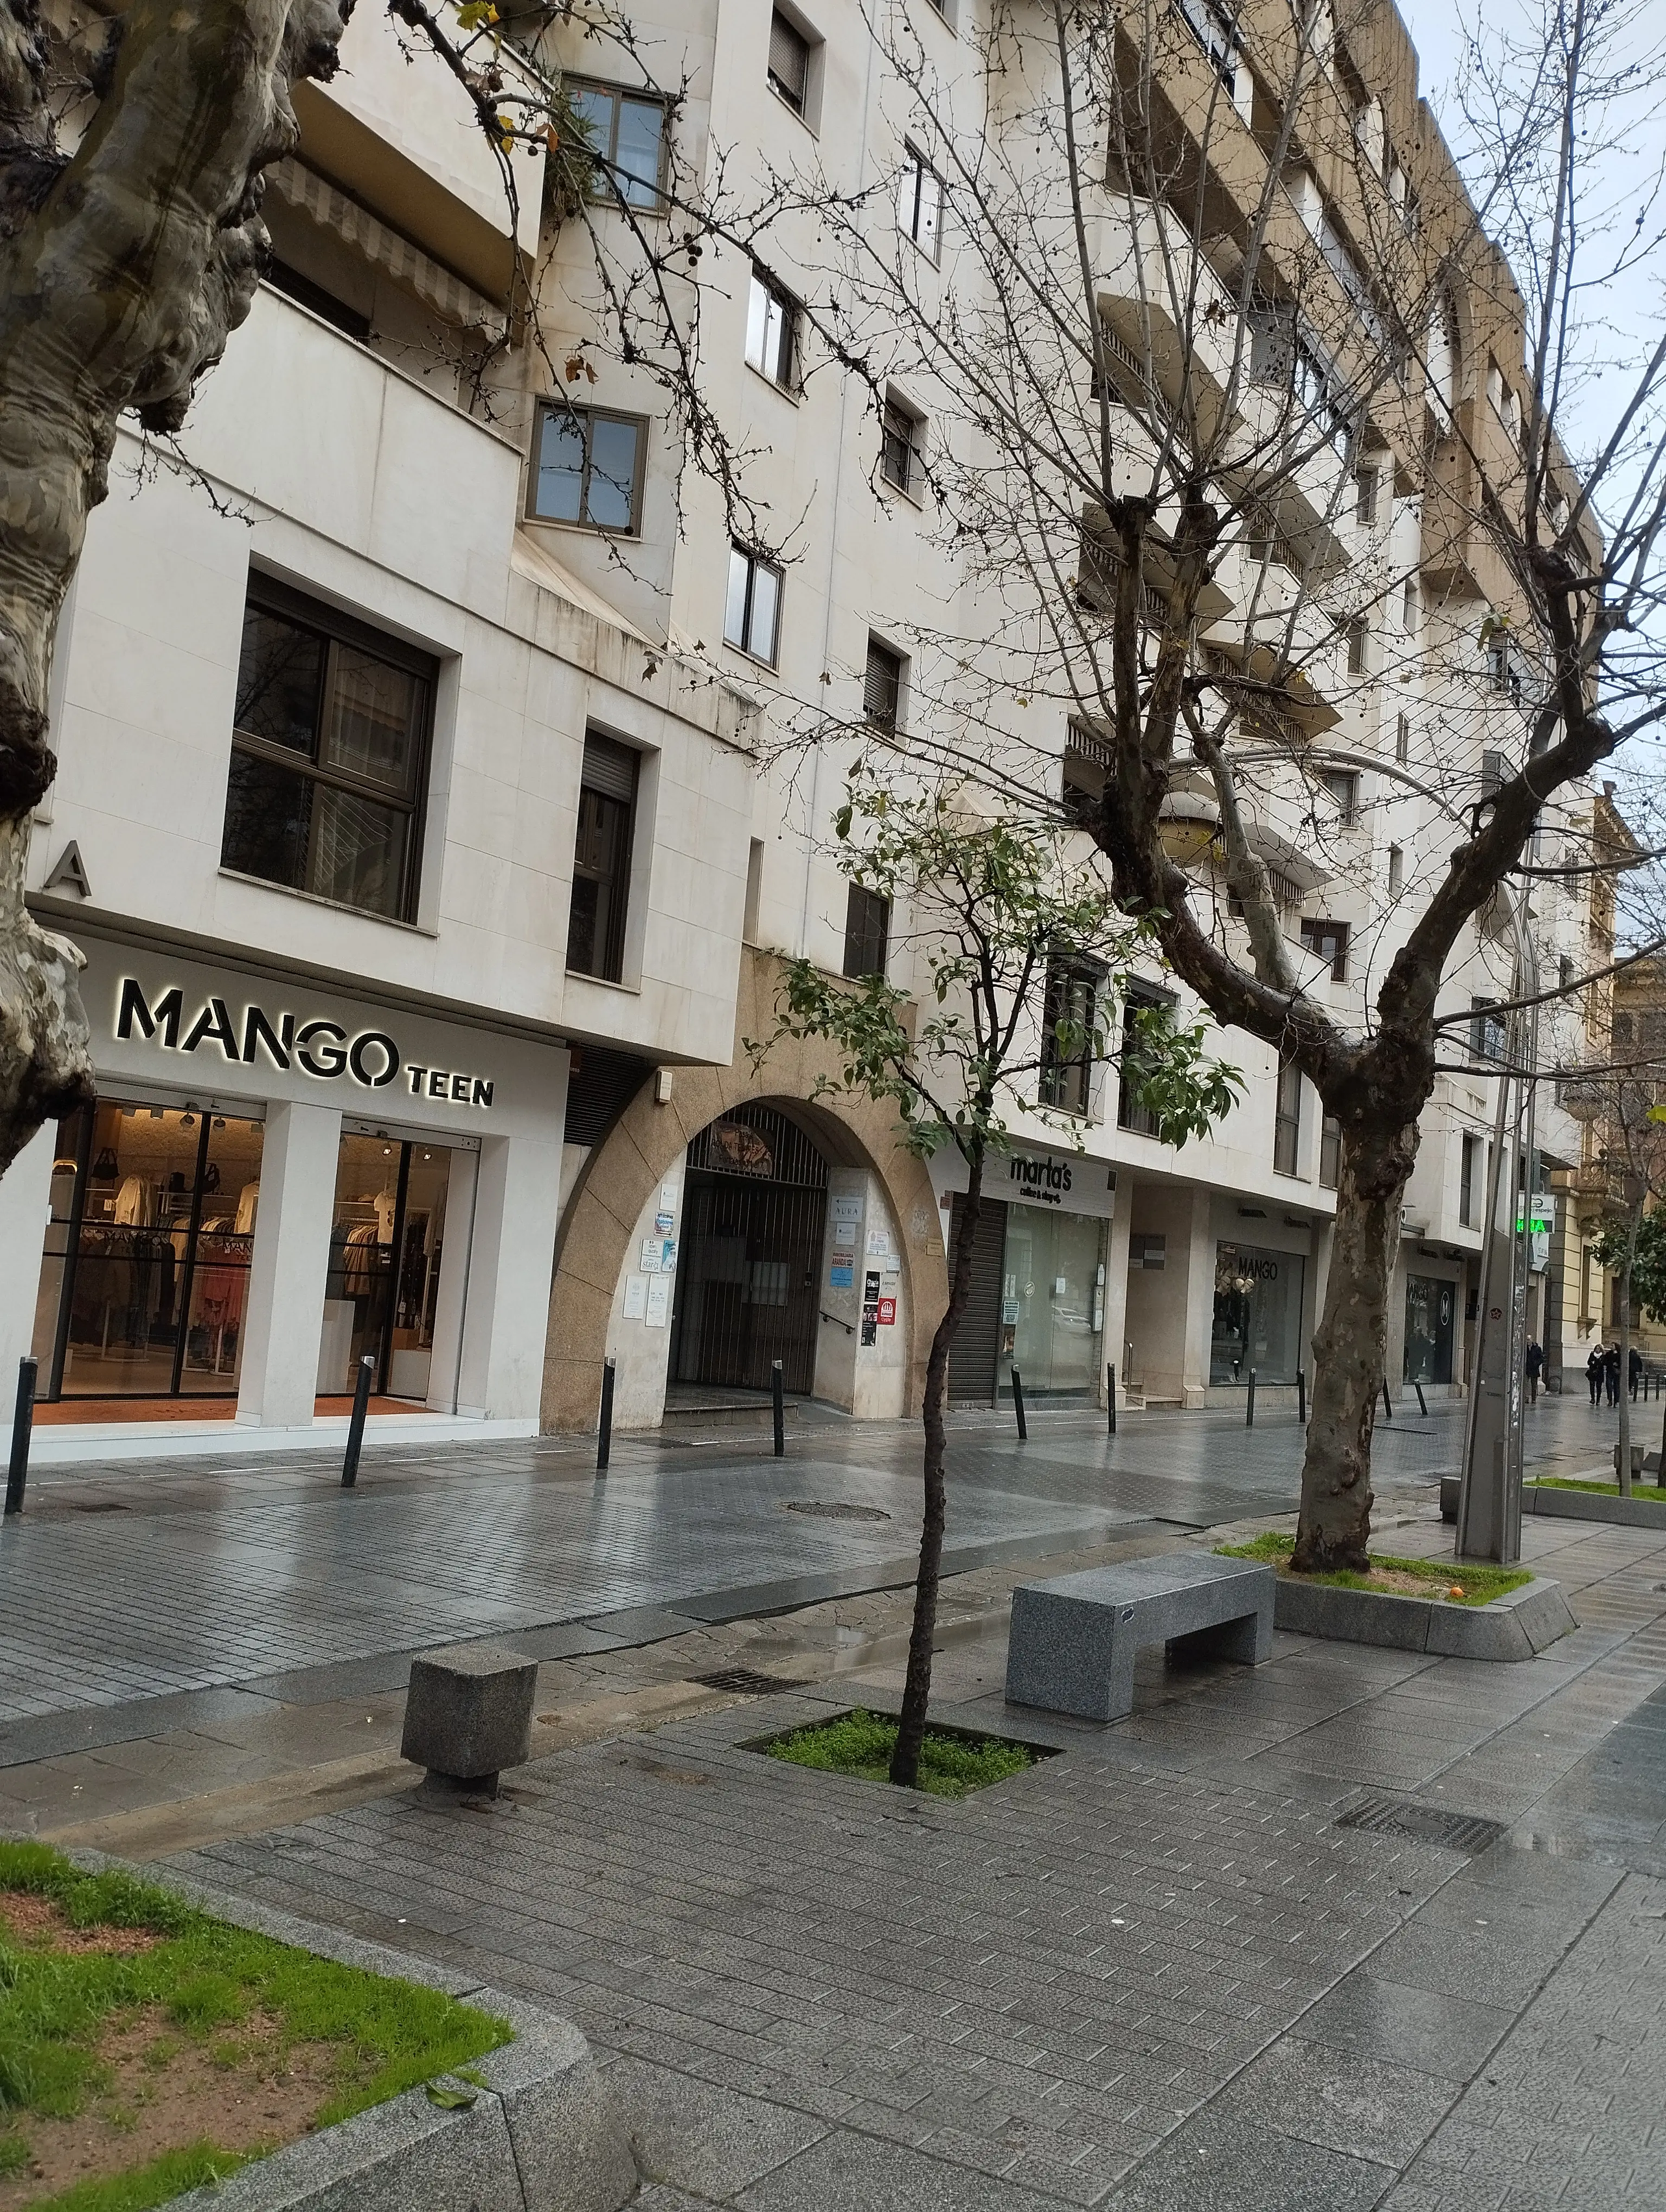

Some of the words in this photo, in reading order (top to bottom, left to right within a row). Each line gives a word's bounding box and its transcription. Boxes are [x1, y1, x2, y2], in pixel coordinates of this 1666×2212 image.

[117, 979, 400, 1086] MANGO
[407, 1066, 495, 1107] TEEN
[1010, 1156, 1072, 1191] marta's
[832, 1258, 847, 1266] ARANDA
[1238, 1257, 1278, 1281] MANGO
